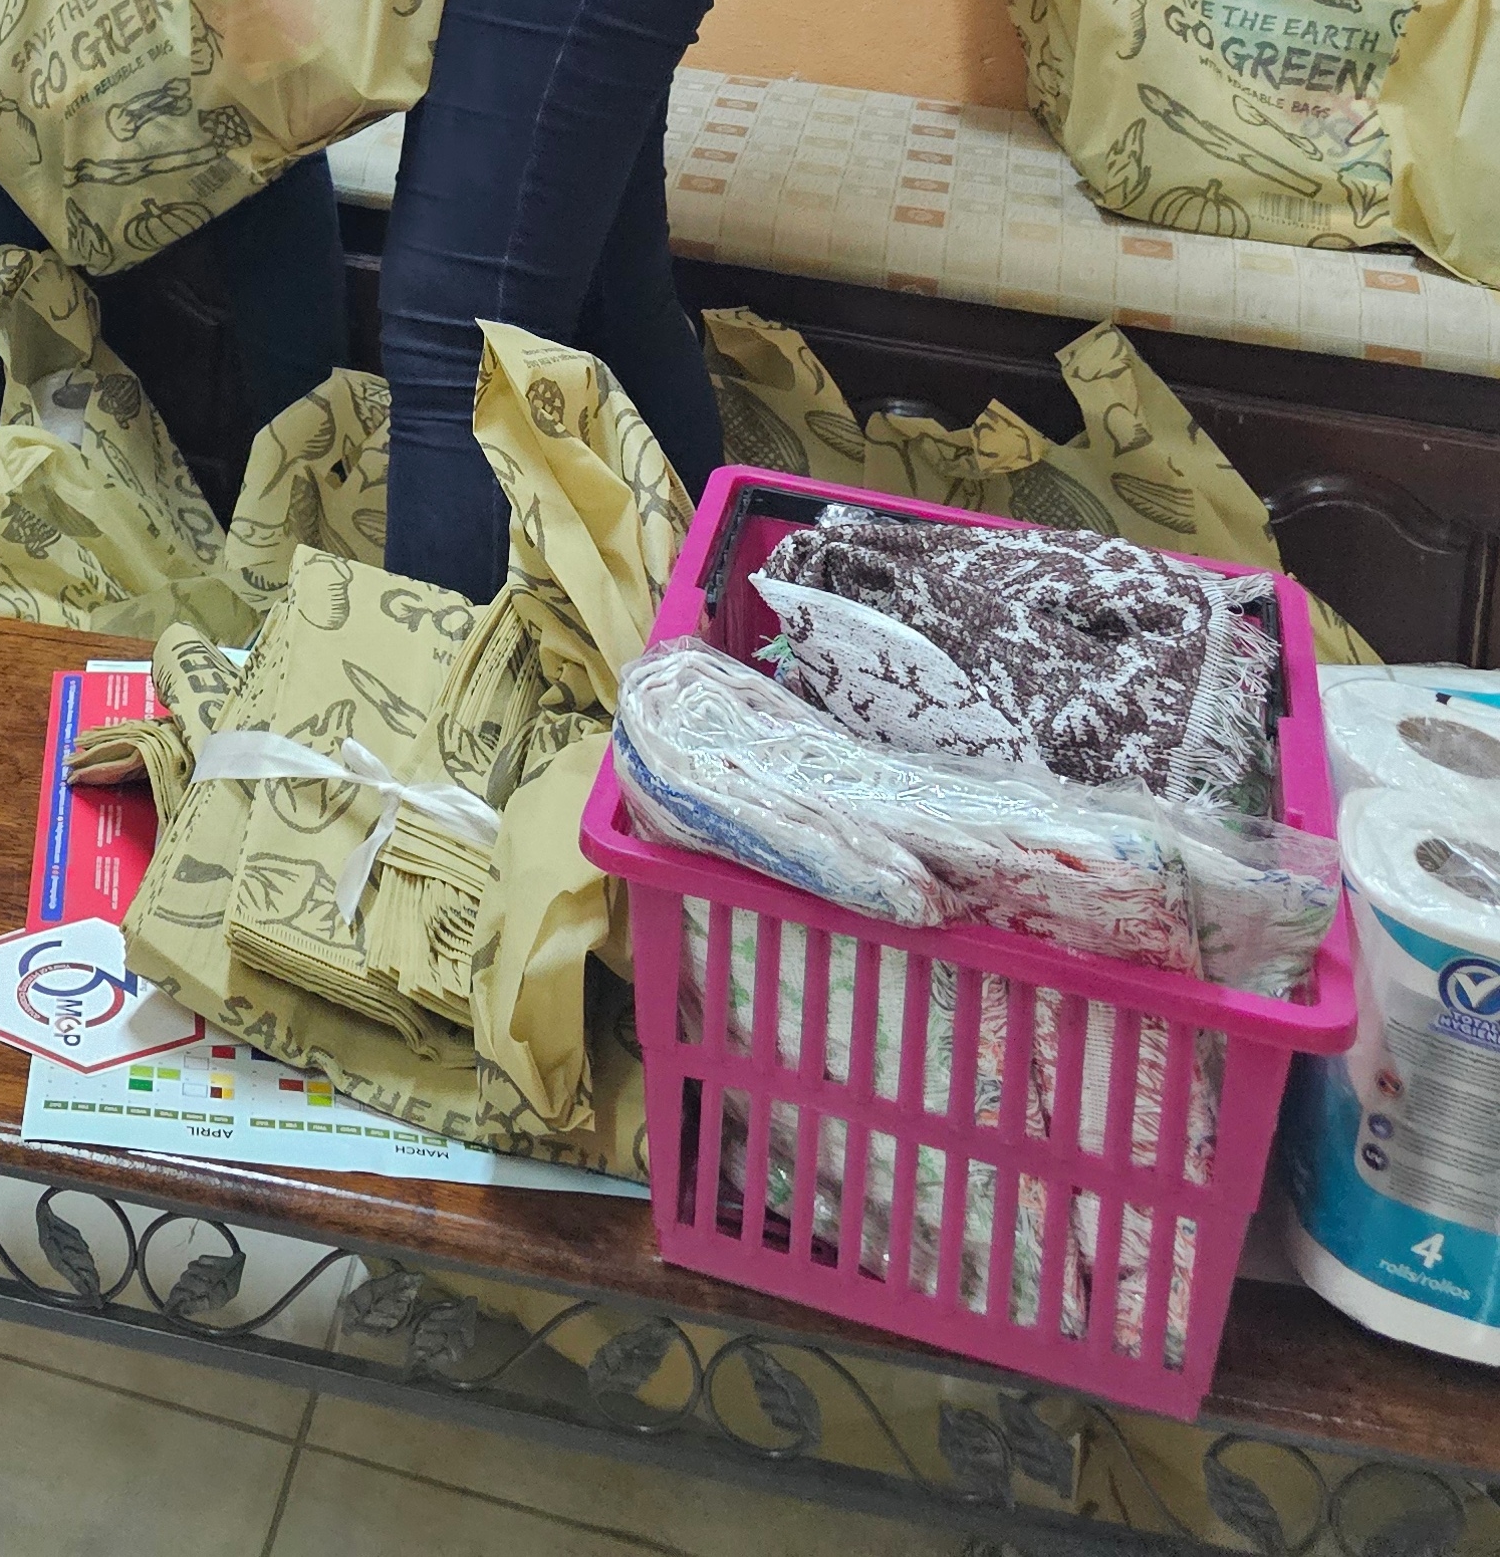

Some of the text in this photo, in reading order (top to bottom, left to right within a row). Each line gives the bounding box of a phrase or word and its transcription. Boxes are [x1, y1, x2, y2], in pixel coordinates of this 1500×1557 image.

[11, 16, 55, 74] SAVE
[1222, 5, 1277, 32] THE
[1283, 18, 1380, 53] EARTH
[1164, 5, 1376, 100] GO GREEN
[30, 50, 68, 109] GO
[1291, 100, 1331, 118] BAGS
[380, 588, 476, 641] GO
[54, 997, 84, 1047] MGP
[1451, 1010, 1498, 1035] TOTAL
[186, 1125, 234, 1140] APRIL
[395, 1144, 450, 1160] MARCH
[1410, 1233, 1445, 1269] 4
[1378, 1258, 1471, 1301] rolls/rollos
